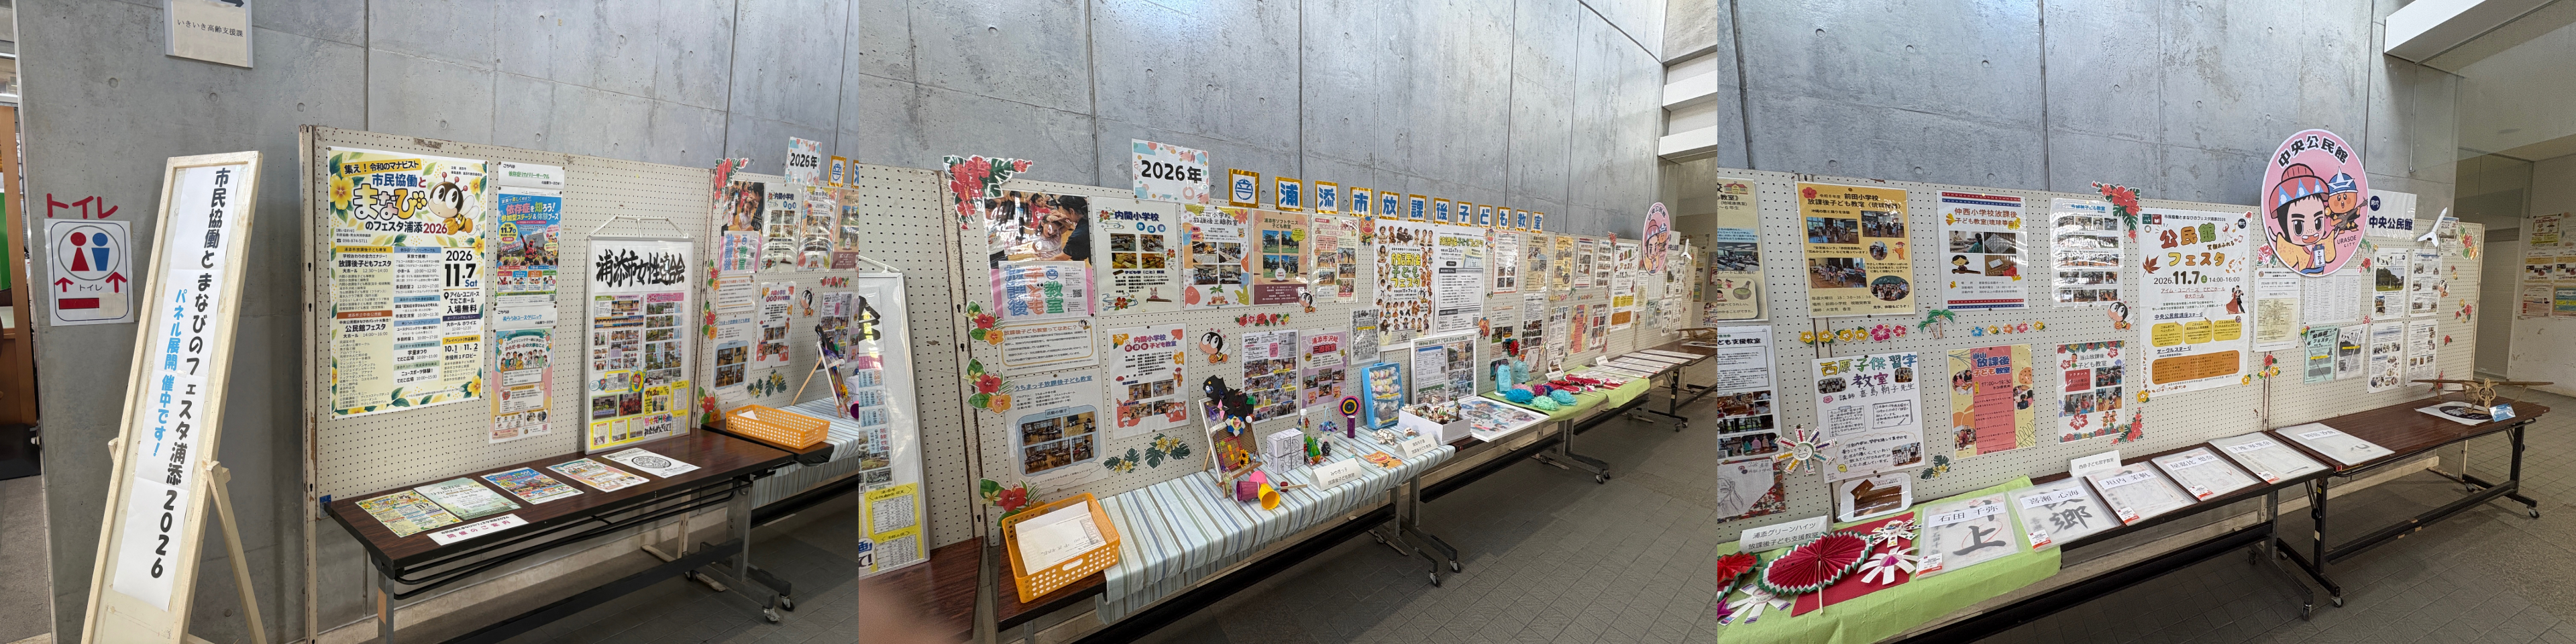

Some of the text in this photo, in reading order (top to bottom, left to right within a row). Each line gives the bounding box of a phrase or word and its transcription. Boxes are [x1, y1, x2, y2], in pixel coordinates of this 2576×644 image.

[177, 19, 244, 37] いきいき高齢支援課
[2278, 136, 2349, 168] 中央公民館
[790, 152, 818, 169] 2026年
[508, 170, 549, 179] 依存症リカバリーサークル
[1141, 159, 1202, 184] 2026年
[372, 173, 427, 188] 市民協働と
[353, 183, 427, 221] まなび
[774, 192, 794, 200] 内間小学校
[1844, 193, 1878, 201] 前田小学校
[46, 193, 119, 219] トイレ
[1114, 210, 1160, 222] 内間小学校
[1955, 207, 2018, 218] 仲西小学校放課後
[365, 221, 447, 234] のフェスタ浦添2026
[2369, 215, 2413, 231] 中央公民館
[1439, 235, 1484, 248] 放課後子どもフェスタ
[2159, 223, 2216, 250] 公民館
[2337, 235, 2357, 245] URASOE
[2206, 241, 2235, 251] 笑顔あふれる
[445, 250, 472, 262] 2026
[1391, 252, 1421, 266] 放課後
[2167, 252, 2225, 266] フェスタ
[596, 248, 685, 288] 浦添市女性連合会
[1392, 265, 1419, 278] 子ども
[445, 264, 476, 286] 11.7
[79, 284, 103, 292] トイレ
[465, 279, 478, 287] Sat
[1391, 278, 1420, 288] フェスタ
[1044, 280, 1065, 314] 教室
[447, 305, 477, 313] 入場無料
[2154, 312, 2203, 321] 中央公民館講座ステージ
[345, 323, 386, 333] 公民館フェスタ
[1004, 325, 1077, 335] 放課後子ども教室ってなあに？
[1134, 334, 1167, 343] 内間小学校
[1313, 343, 1336, 354] 三線教室
[2156, 345, 2192, 354] サークルステージ
[1820, 354, 1917, 377] 西原子供習字
[1977, 356, 2010, 368] 放課後
[2078, 360, 2107, 368] 子ども教室
[1973, 366, 2010, 377] 子ども教室
[1014, 375, 1093, 391] うちまっ子放課後子ども教室
[1851, 372, 1888, 388] 教室
[2078, 458, 2114, 470] 西原子ども習字教室
[1330, 467, 1348, 476] みやぎっ子
[1328, 472, 1355, 486] 放課後子ども教室
[1938, 511, 1966, 522] 石田
[1753, 521, 1816, 539] 浦添グリーンハイツ
[1748, 531, 1819, 551] 放課後子ども支援教室
[1952, 525, 2006, 556] 上
